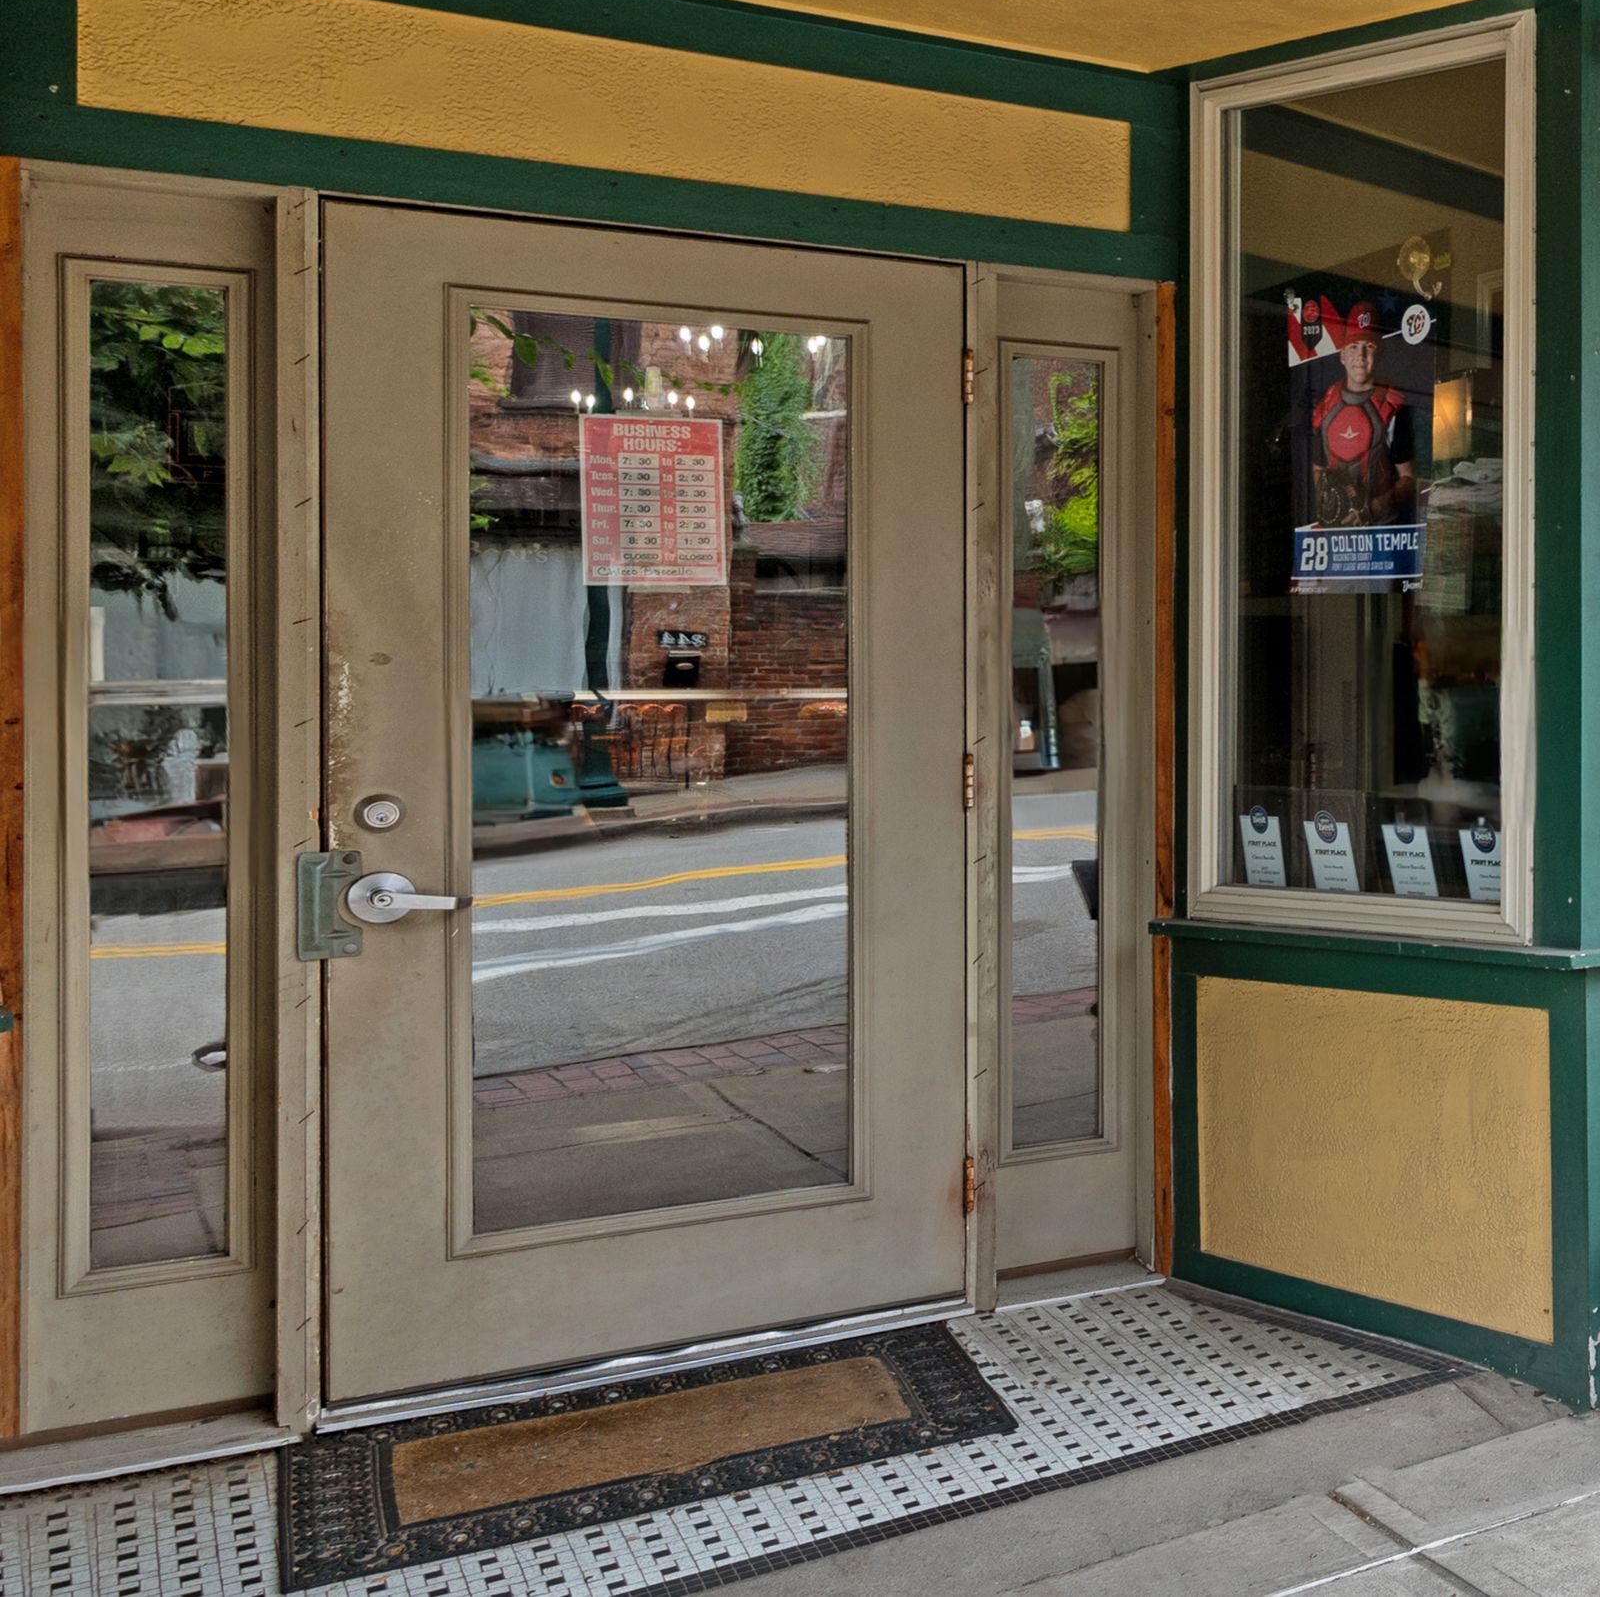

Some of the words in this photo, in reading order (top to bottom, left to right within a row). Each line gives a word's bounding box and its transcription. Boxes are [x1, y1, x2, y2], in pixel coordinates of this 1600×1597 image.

[612, 423, 692, 439] BUSINESS
[623, 438, 682, 452] HOURS:
[1331, 534, 1373, 553] COLTON
[1376, 532, 1419, 552] TEMPLE
[623, 553, 660, 561] CLOSED
[1300, 536, 1329, 572] 28
